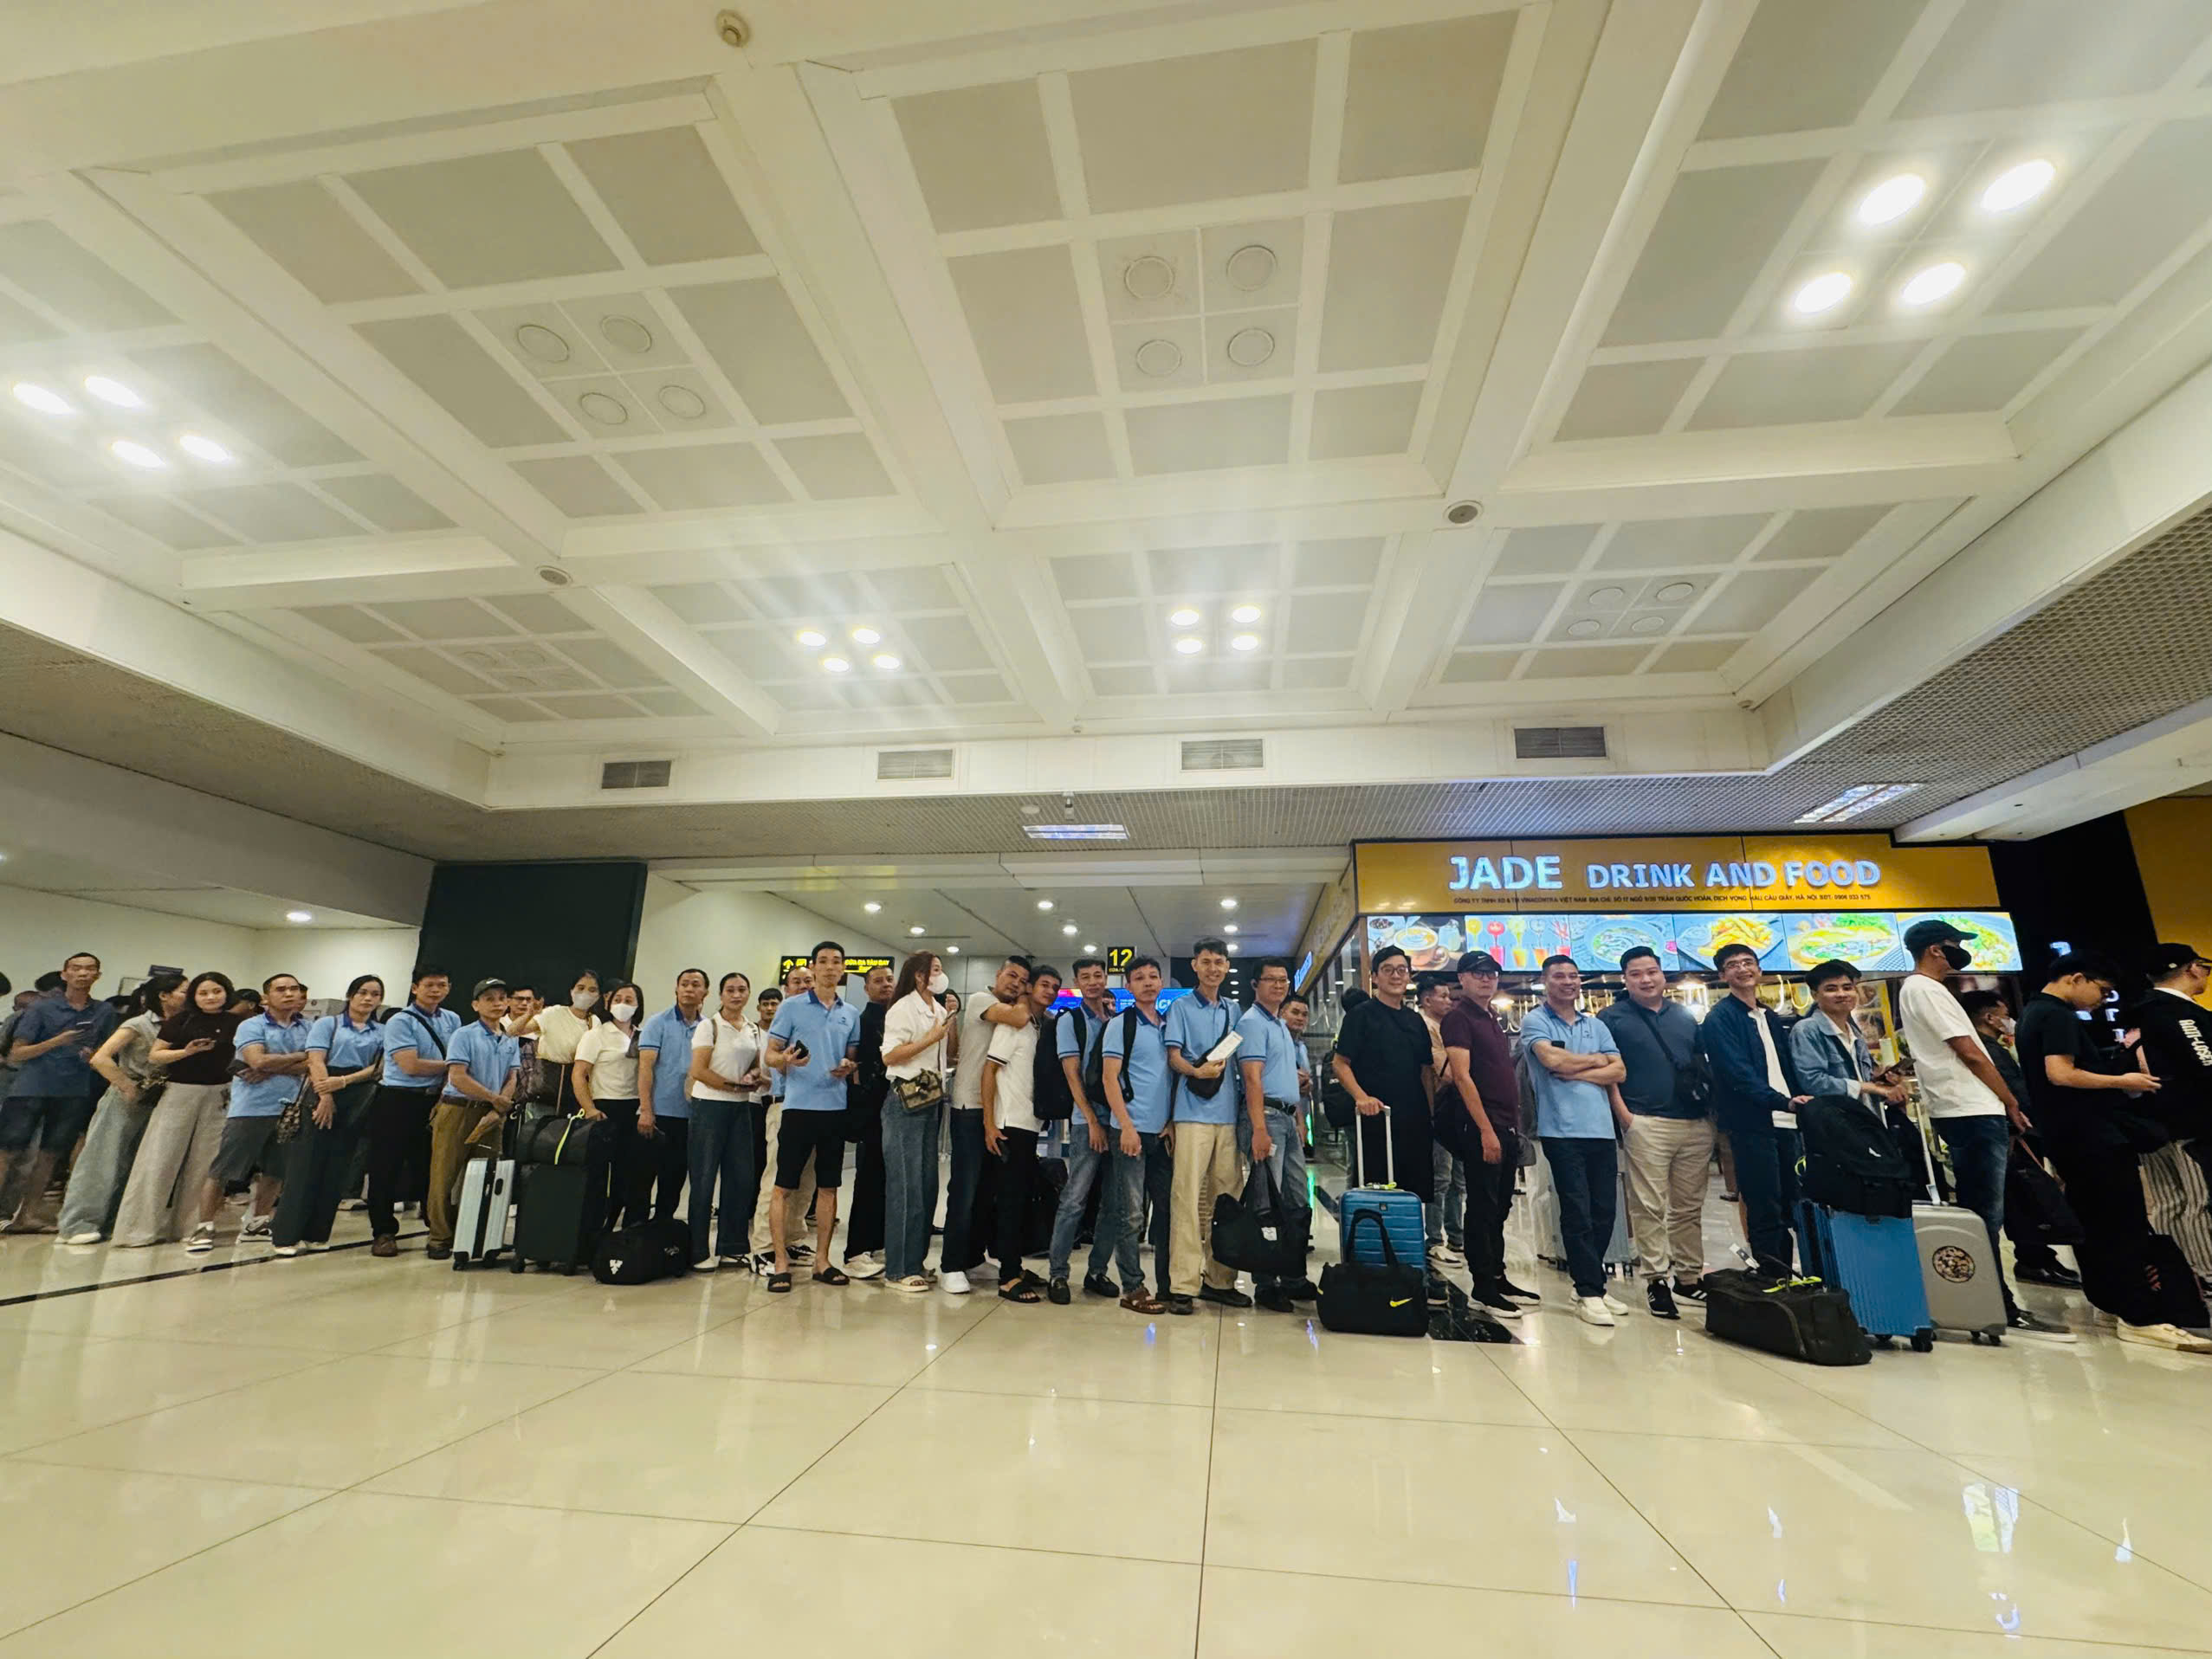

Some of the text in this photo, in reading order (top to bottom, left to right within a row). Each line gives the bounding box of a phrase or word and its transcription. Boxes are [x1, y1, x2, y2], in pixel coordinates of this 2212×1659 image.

[1449, 855, 1881, 890] JADE DRINK AND FOOD
[1109, 948, 1133, 966] 12
